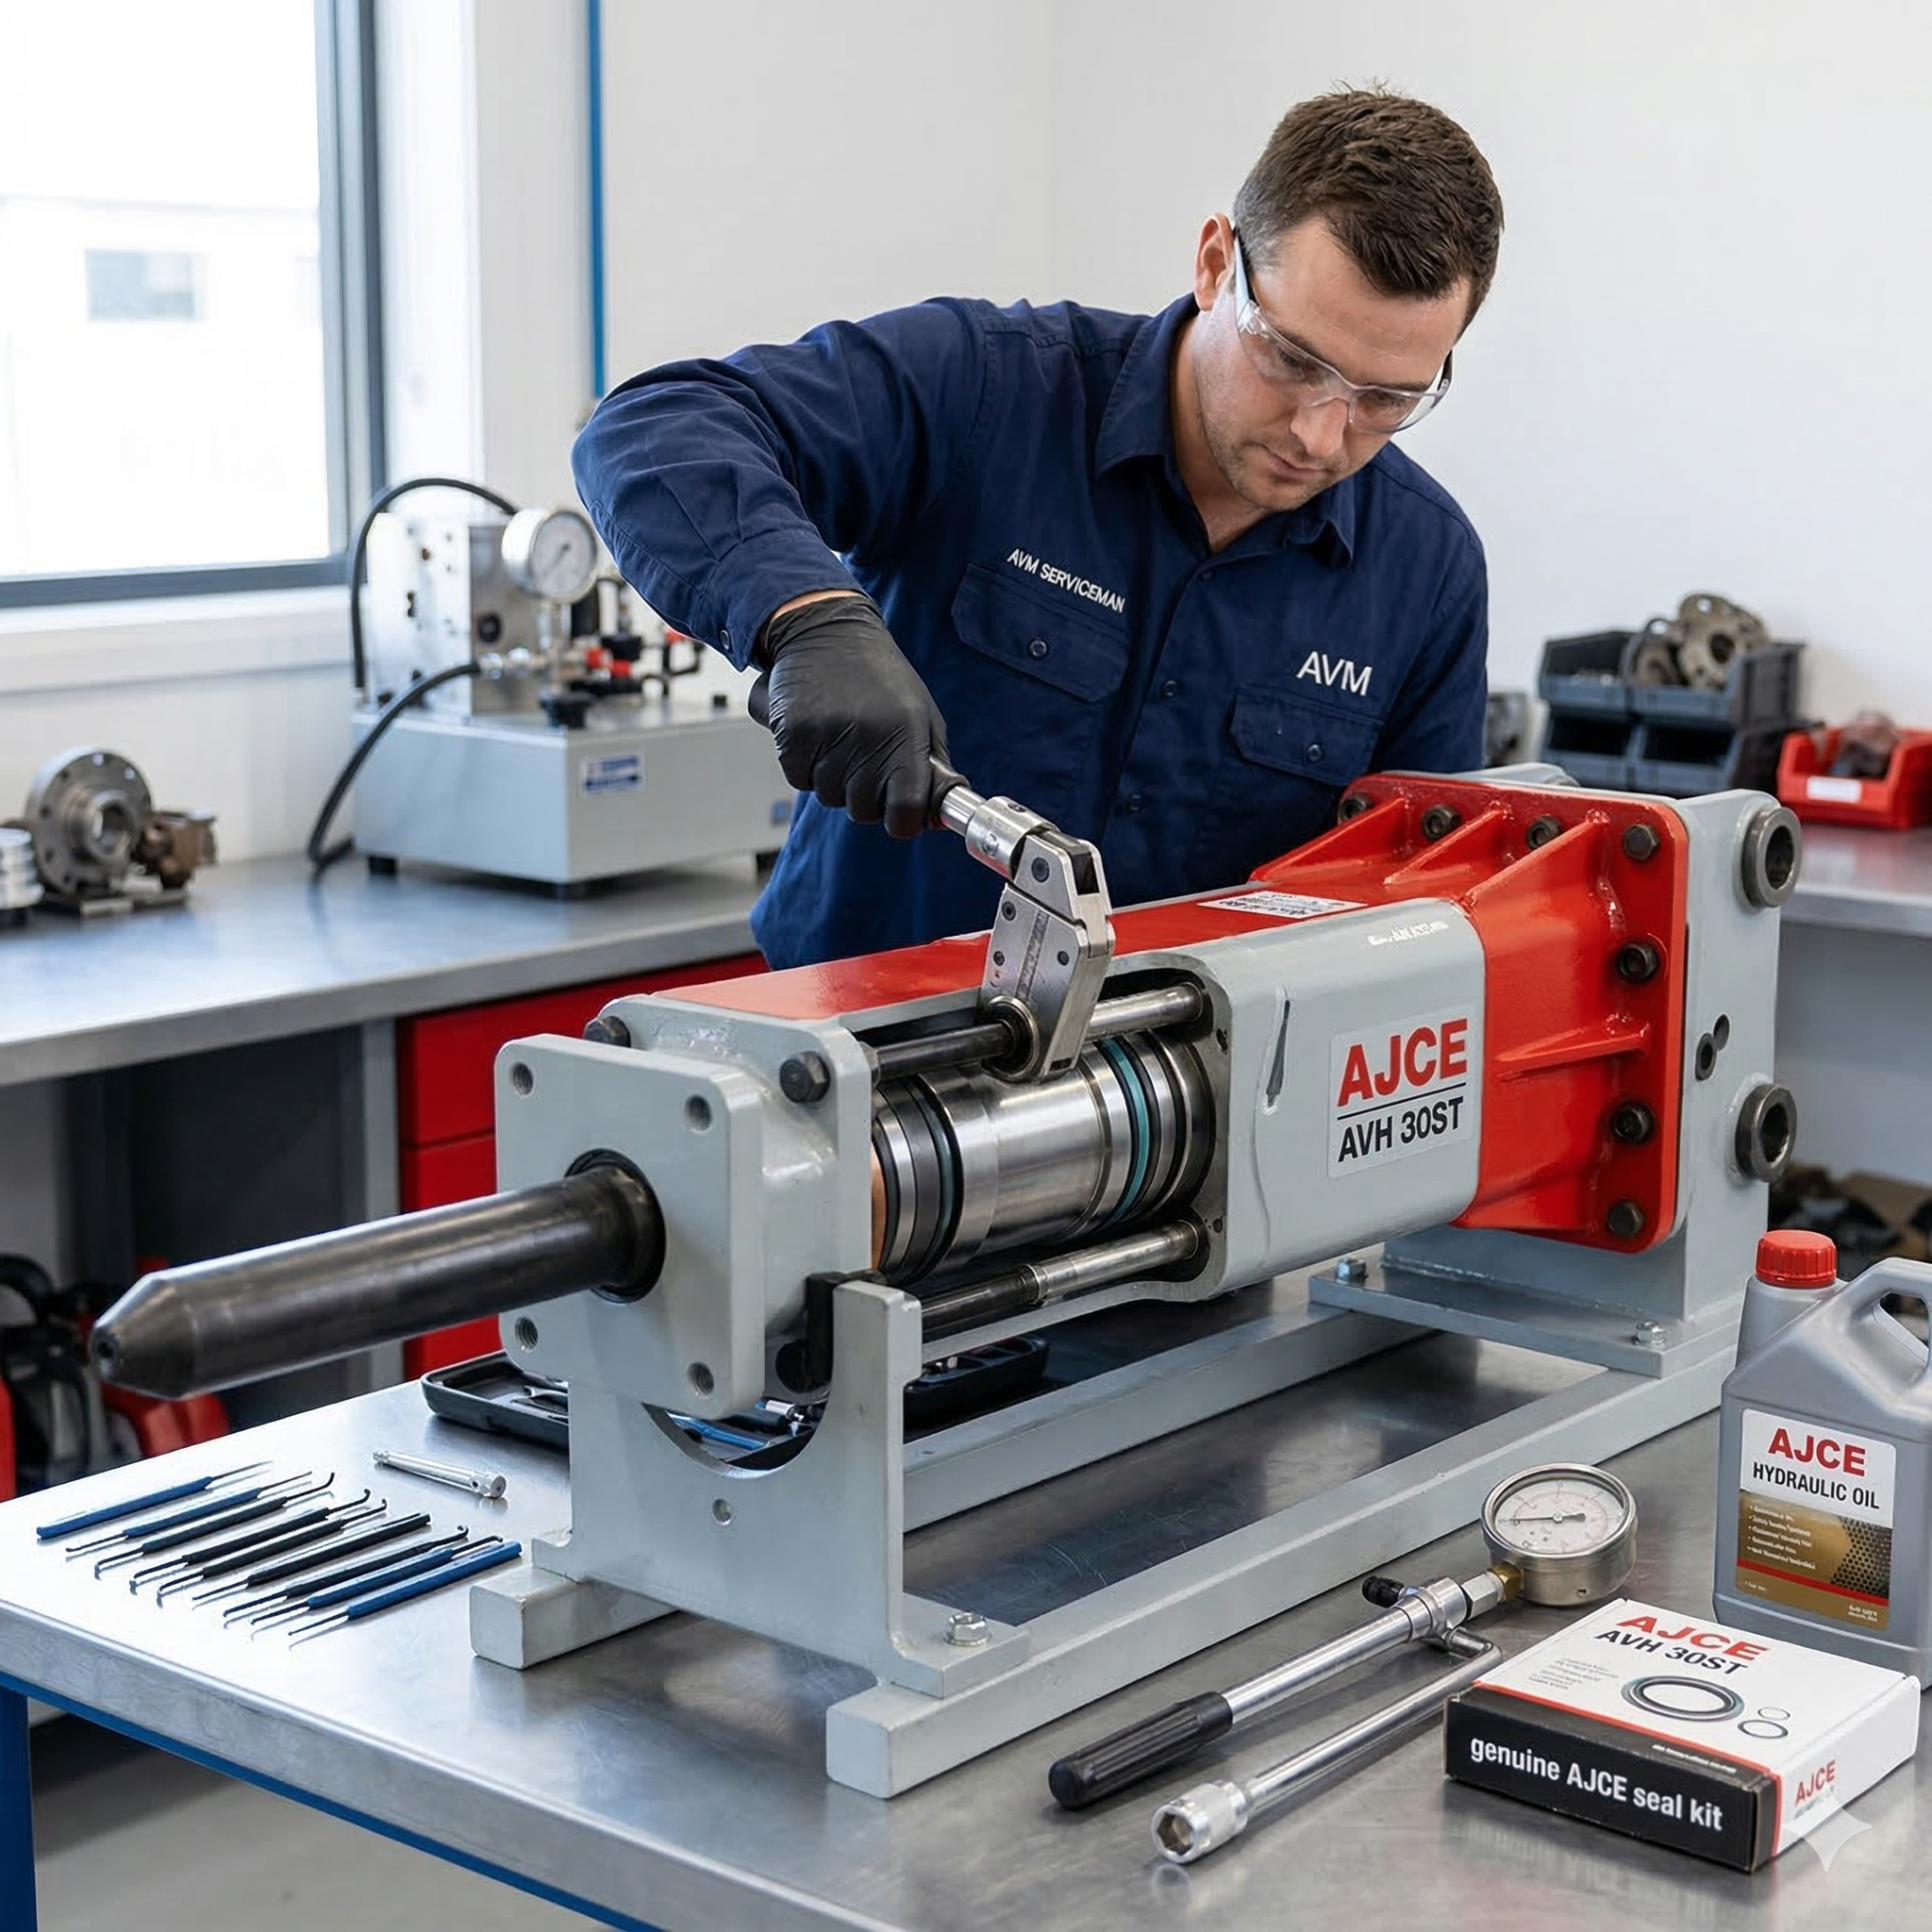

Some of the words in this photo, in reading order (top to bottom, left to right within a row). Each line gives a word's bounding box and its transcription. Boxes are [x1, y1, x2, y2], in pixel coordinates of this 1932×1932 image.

[1007, 548, 1039, 575] AVM
[1040, 563, 1125, 613] SERVICEMAN
[1296, 651, 1373, 696] AVM
[1337, 1018, 1468, 1108] AJCE
[1338, 1115, 1392, 1163] AVH
[1400, 1095, 1465, 1144] 30ST
[1767, 1427, 1867, 1476] AJCE
[1753, 1461, 1847, 1502] HYDRAULIC
[1852, 1487, 1880, 1509] OIL
[1594, 1630, 1664, 1654] AVH
[1664, 1646, 1749, 1674] 30ST
[1616, 1615, 1769, 1661] AJCE
[1470, 1738, 1560, 1781] genuine
[1566, 1762, 1628, 1802] AJCE
[1633, 1787, 1682, 1819] seal
[1690, 1798, 1724, 1831] kit
[1794, 1758, 1836, 1807] AJCE
